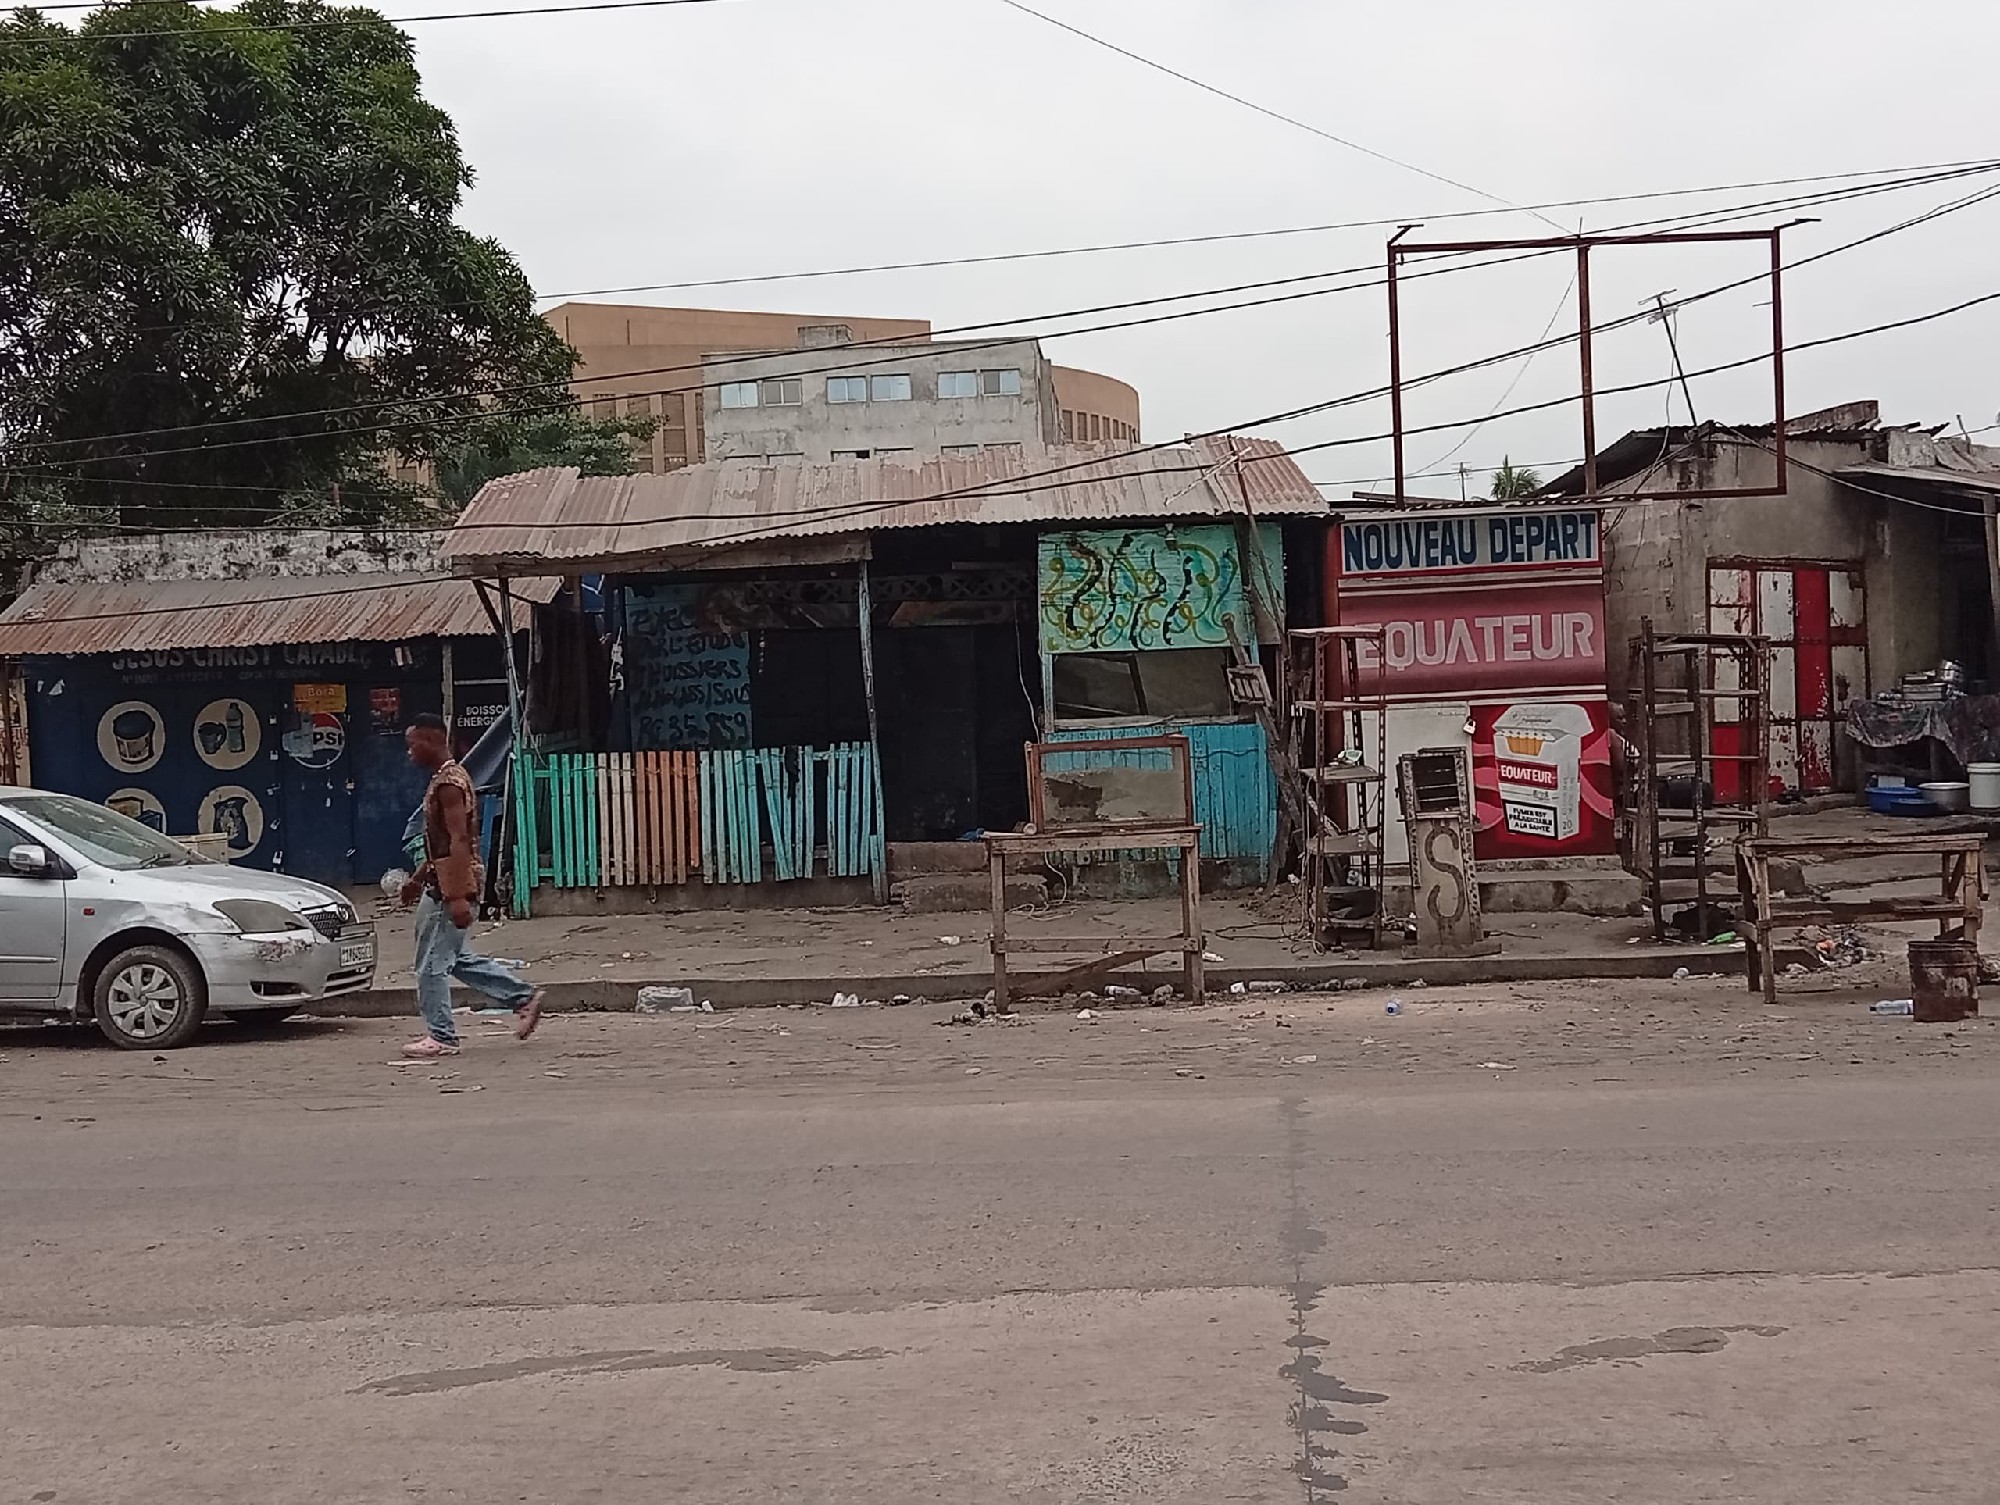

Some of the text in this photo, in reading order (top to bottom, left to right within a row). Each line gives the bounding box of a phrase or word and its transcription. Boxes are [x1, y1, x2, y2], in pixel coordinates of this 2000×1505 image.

[1343, 513, 1596, 572] NOUVEAU DEPART
[1355, 611, 1595, 671] EQUATEUR
[466, 704, 507, 716] BOISSO
[457, 714, 496, 727] ÉNERG
[313, 732, 342, 745] PSI
[1500, 764, 1553, 784] EQUATEUR
